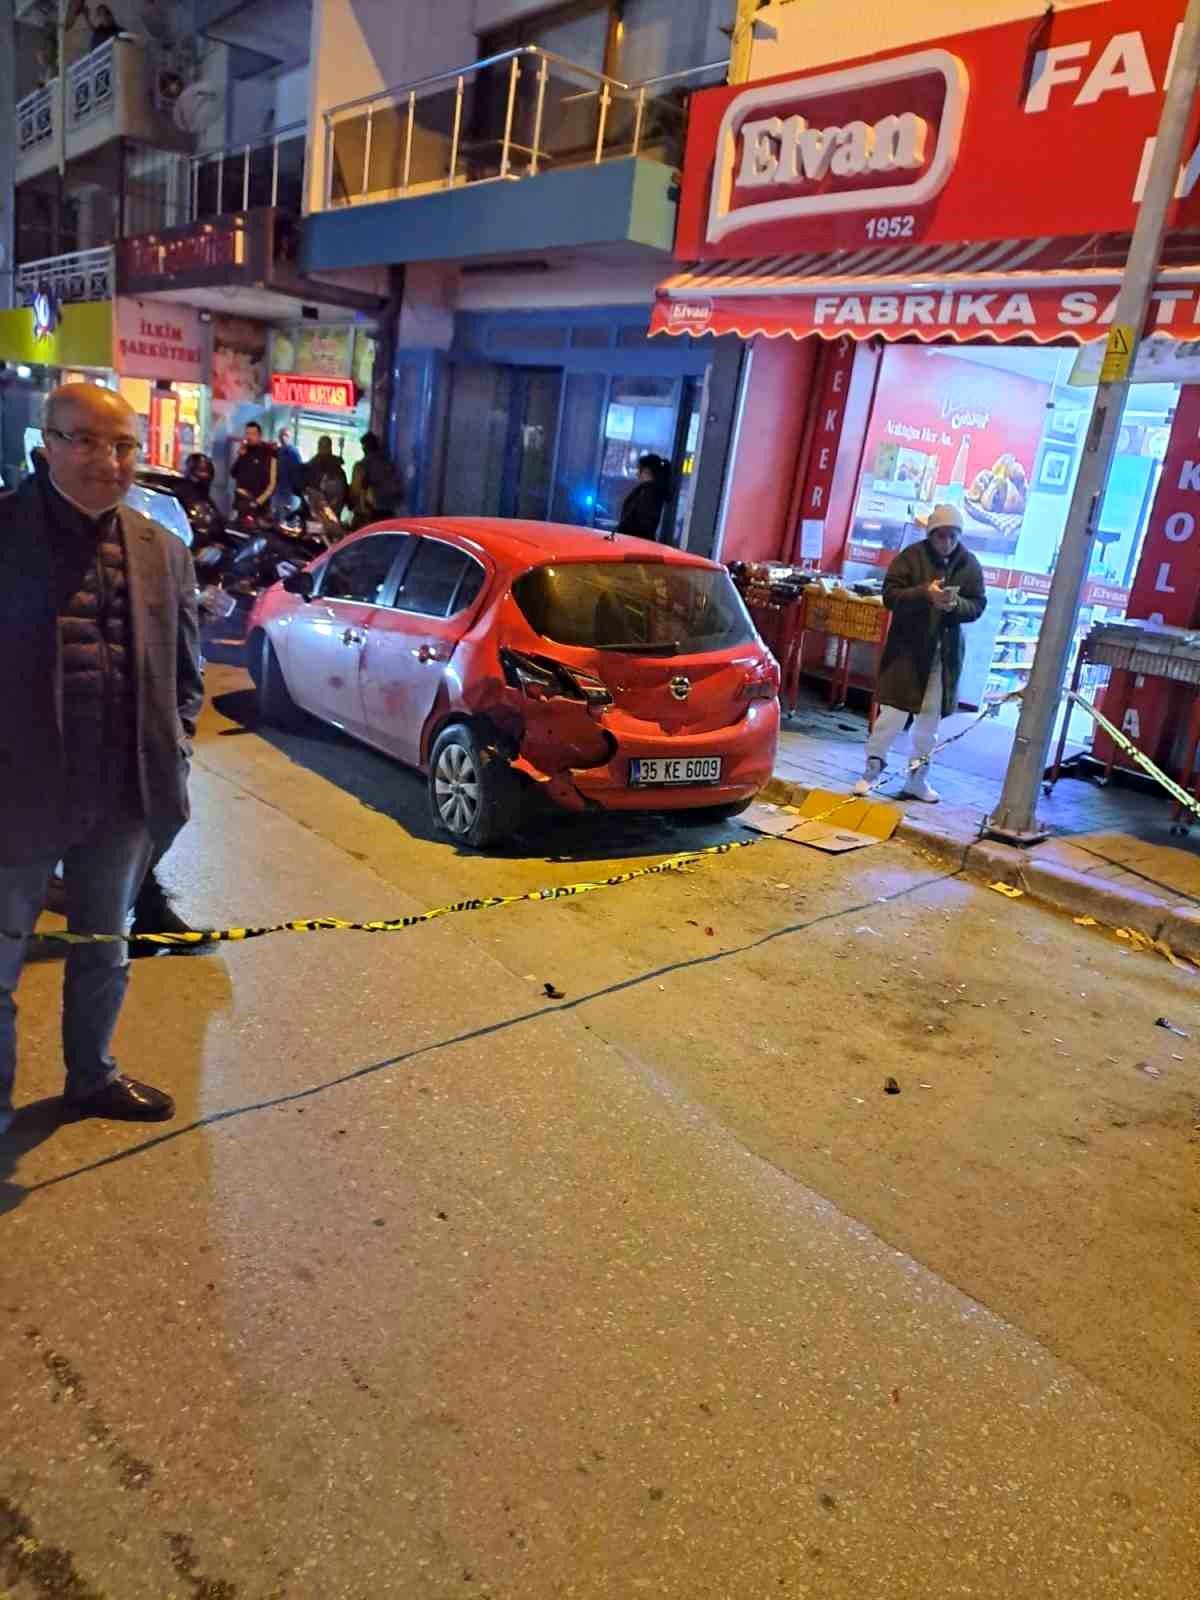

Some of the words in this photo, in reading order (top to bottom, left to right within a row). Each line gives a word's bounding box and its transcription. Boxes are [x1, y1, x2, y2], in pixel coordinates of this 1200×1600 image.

[1024, 22, 1184, 114] FA
[735, 112, 927, 187] Elvan
[866, 216, 915, 239] 1952
[672, 303, 710, 318] Elvan
[813, 288, 1037, 325] FABRİKA
[640, 761, 657, 780] 35
[664, 761, 681, 779] KE
[686, 760, 718, 778] 6009
